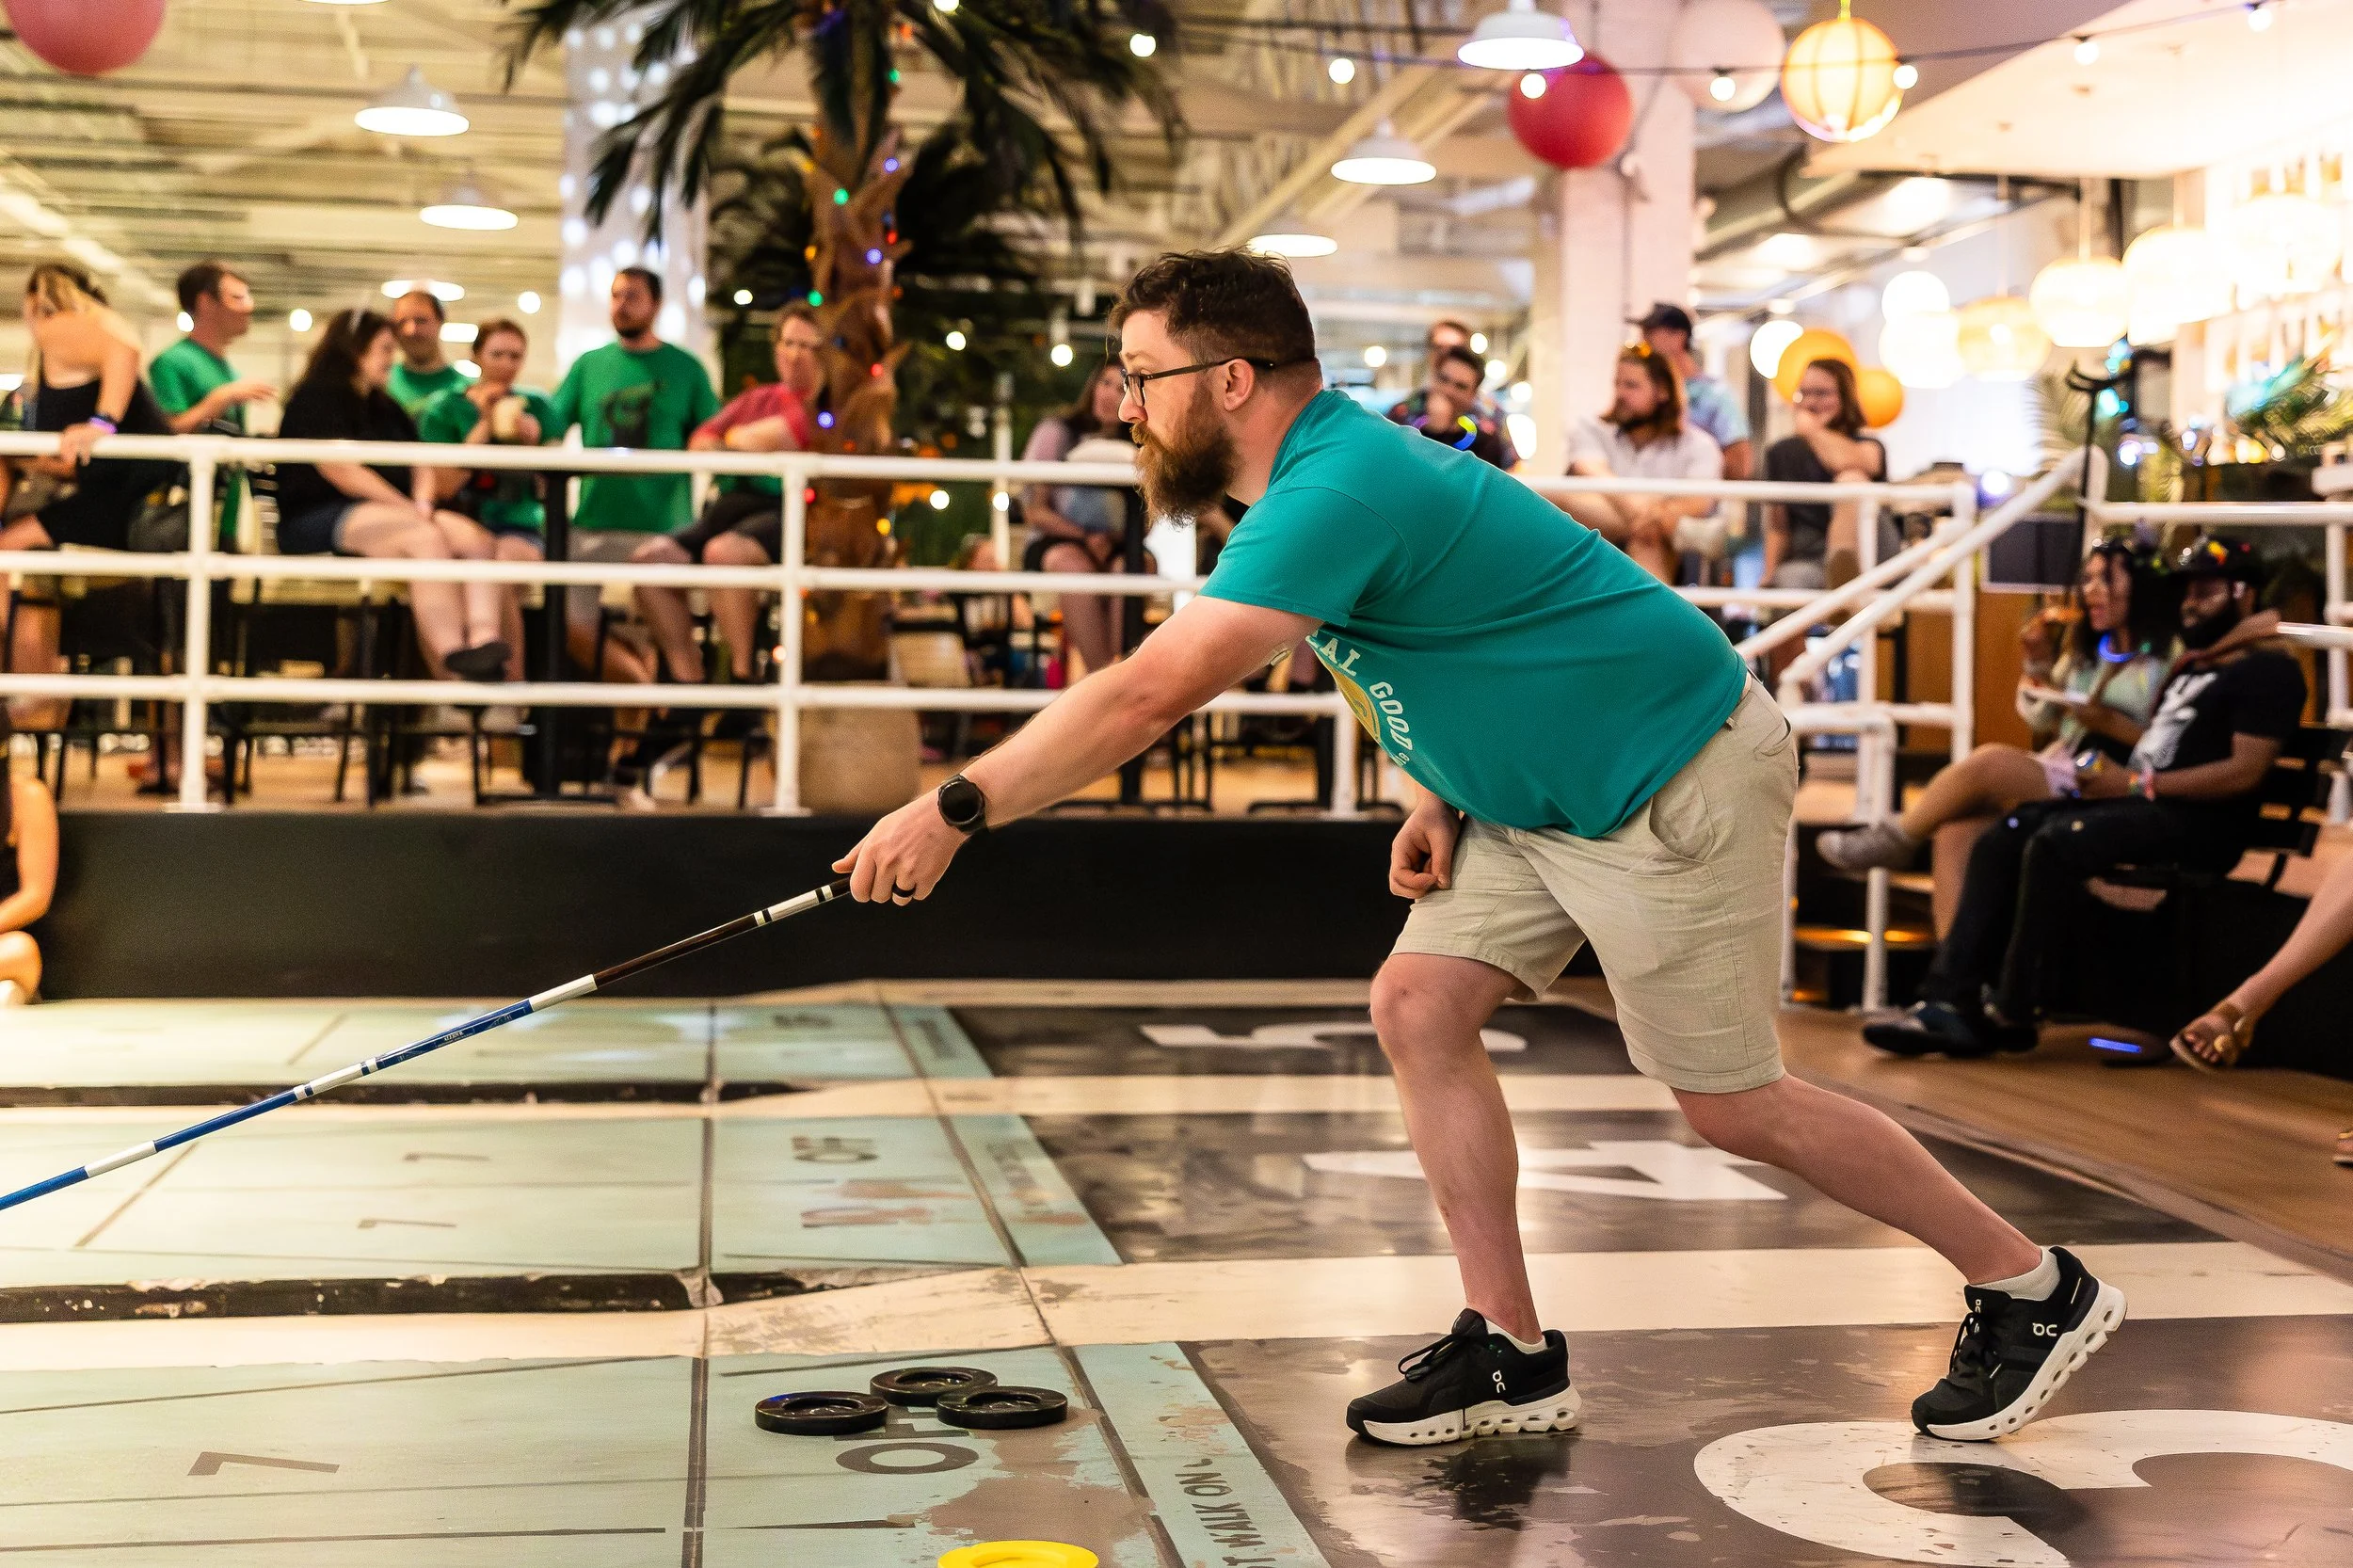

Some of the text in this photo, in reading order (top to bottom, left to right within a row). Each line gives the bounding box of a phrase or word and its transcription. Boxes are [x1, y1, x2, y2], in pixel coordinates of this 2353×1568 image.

[1369, 681, 1413, 750] GOOD
[1174, 1472, 1233, 1497] ON
[1191, 1501, 1267, 1548] WALK
